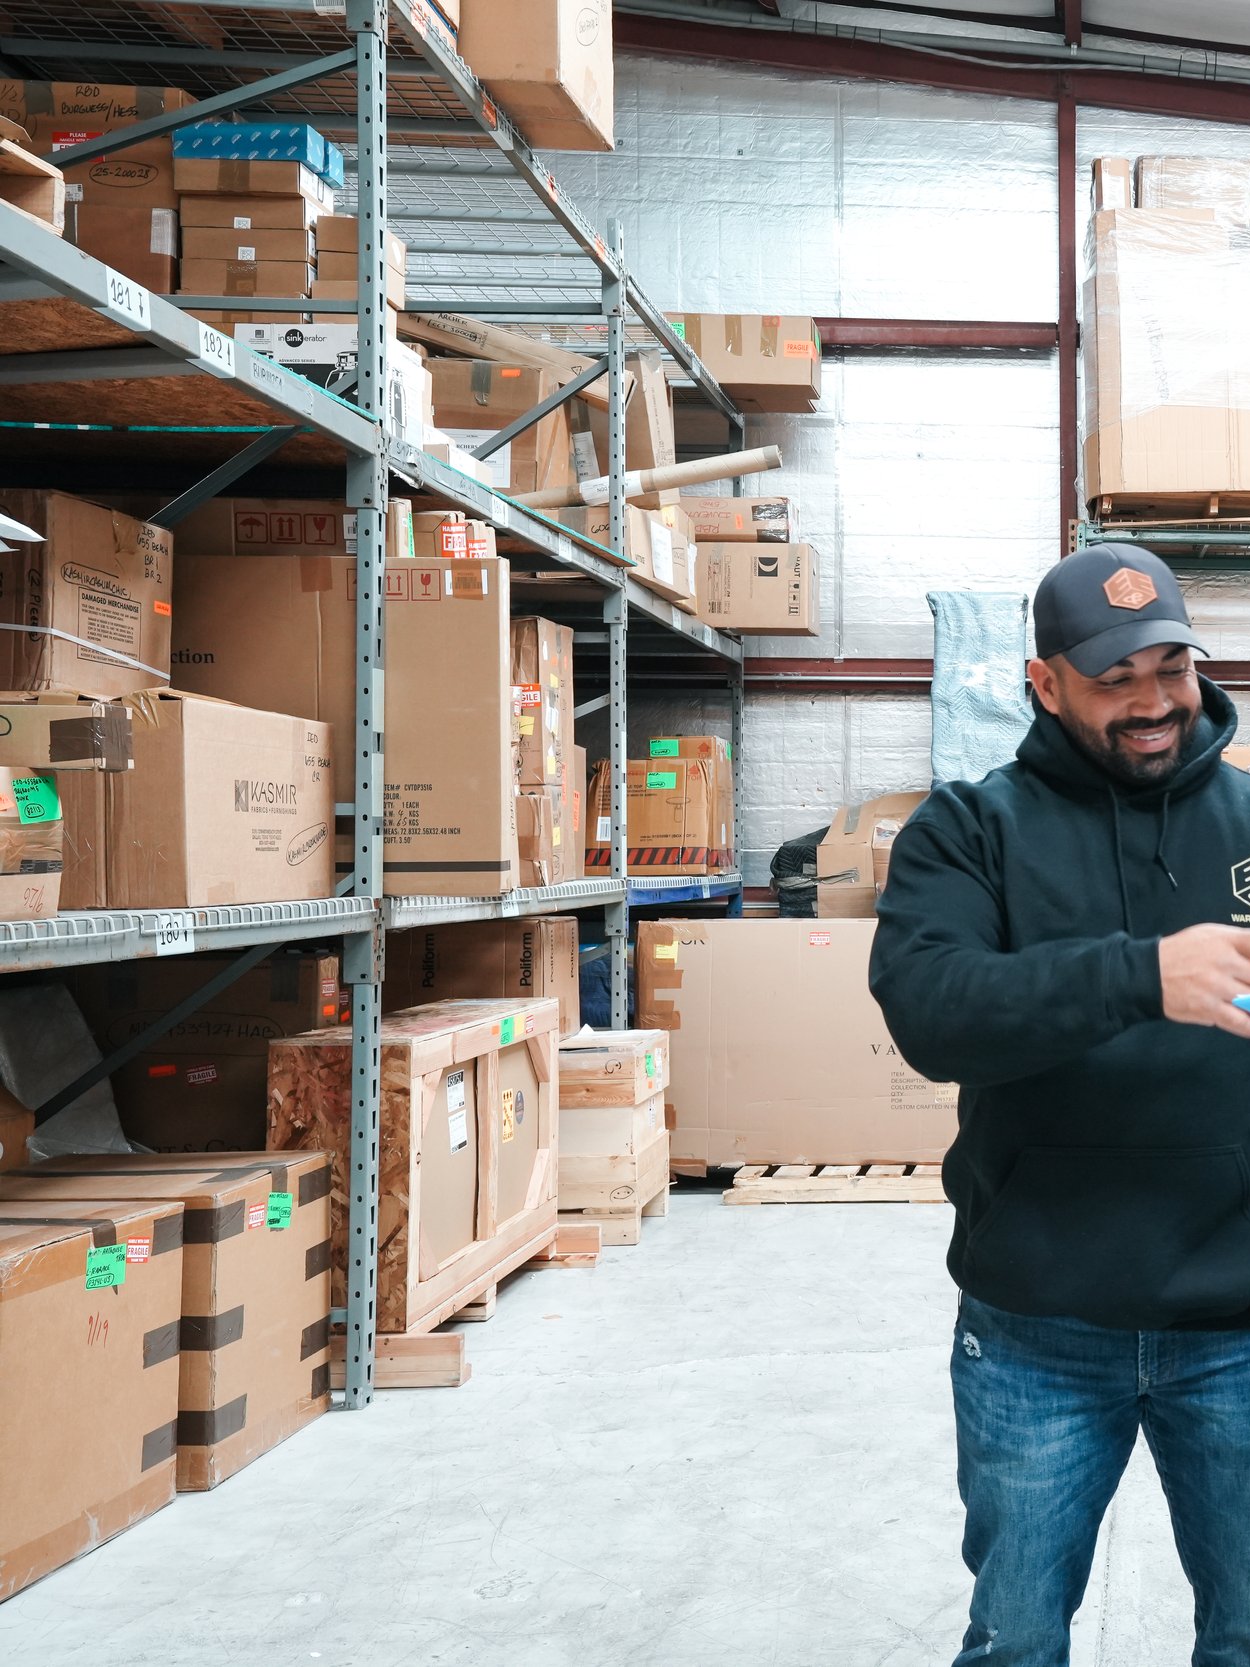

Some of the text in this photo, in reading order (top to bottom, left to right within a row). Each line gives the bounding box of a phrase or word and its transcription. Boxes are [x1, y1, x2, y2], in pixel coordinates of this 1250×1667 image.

[110, 278, 132, 311] 181
[203, 330, 223, 359] 182
[786, 343, 809, 351] FRAGILE
[81, 593, 107, 605] DAMAGED
[107, 599, 139, 614] MERCHANDISE
[250, 780, 298, 805] KASMIR
[422, 933, 436, 988] Poliform
[519, 932, 532, 987] Poliform
[128, 1246, 149, 1256] FRAGILE
